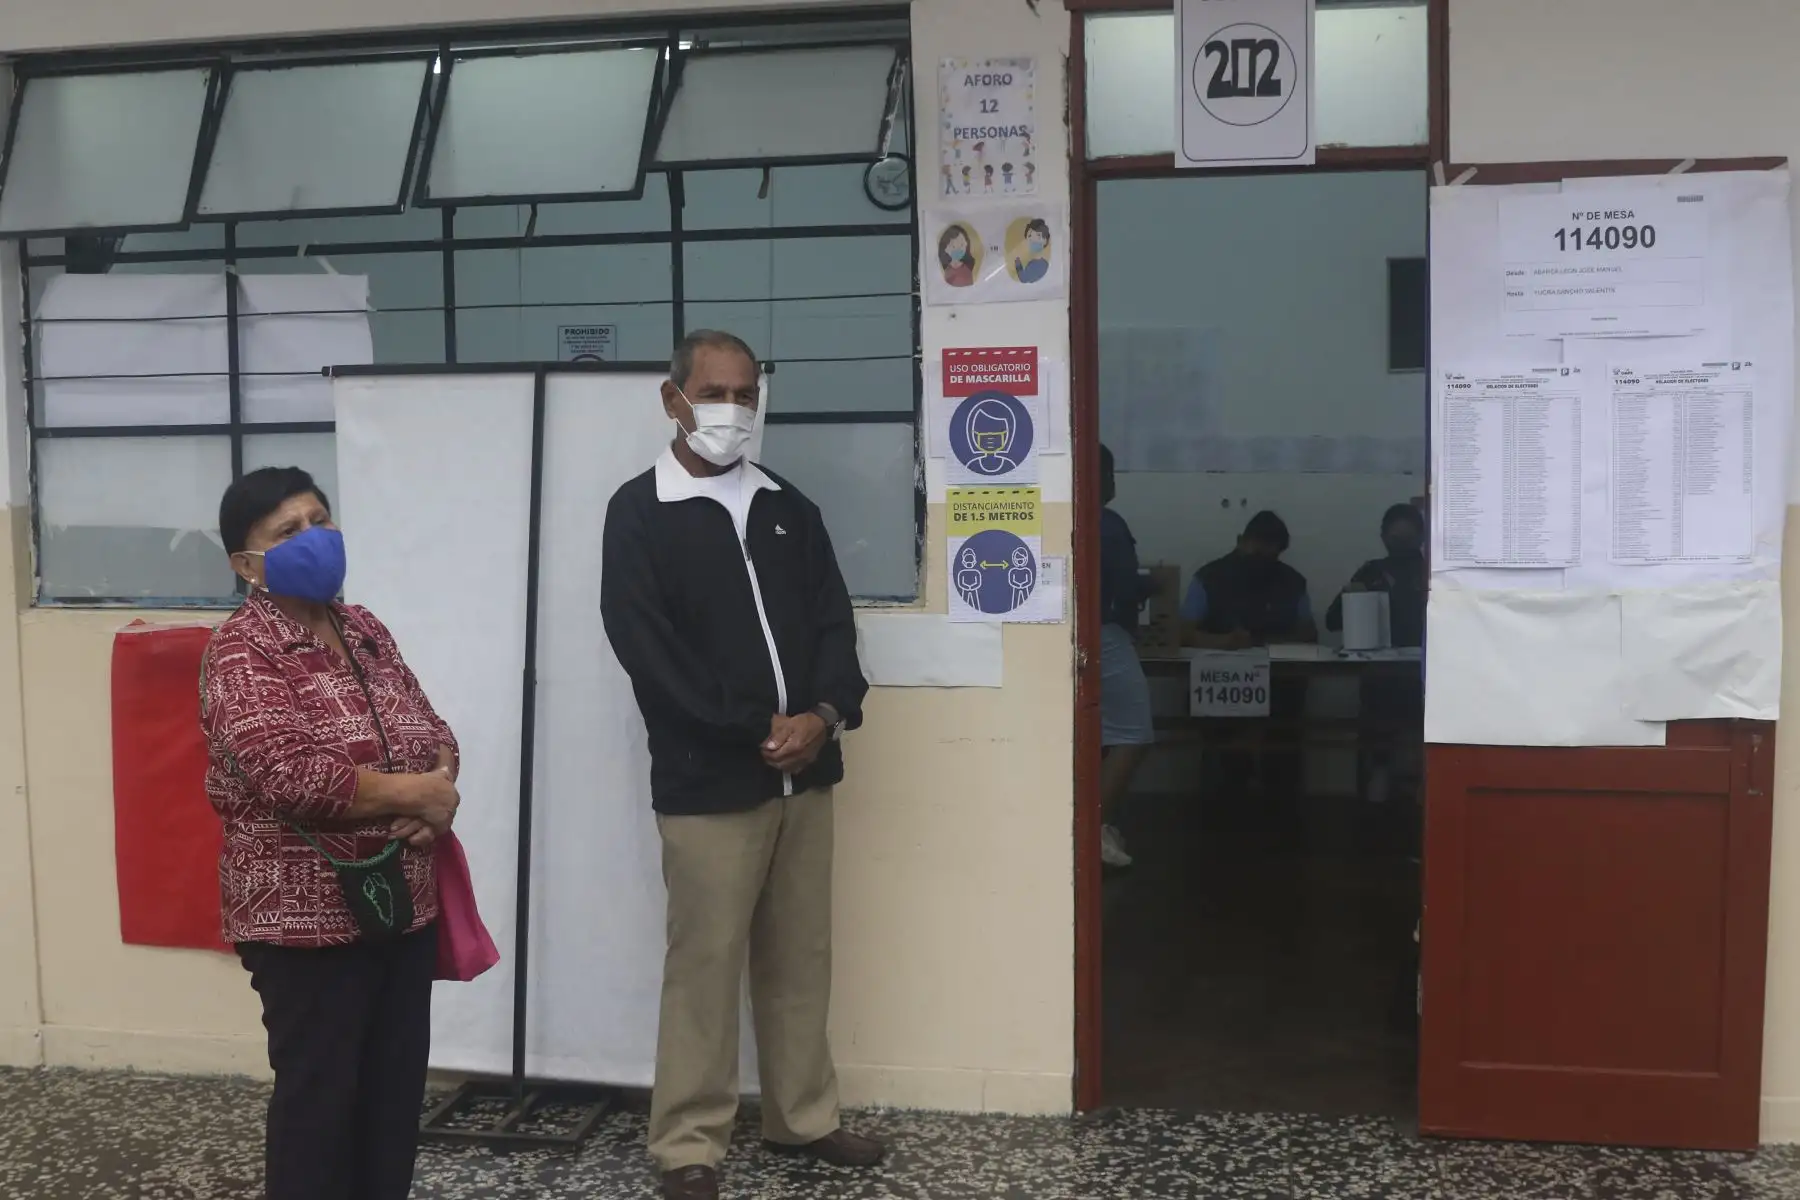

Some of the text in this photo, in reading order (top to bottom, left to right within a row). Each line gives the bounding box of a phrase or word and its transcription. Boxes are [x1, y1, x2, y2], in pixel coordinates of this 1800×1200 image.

[964, 73, 1013, 87] AFORO
[979, 99, 999, 114] 12
[953, 125, 1028, 140] PERSONAS
[1587, 211, 1601, 220] DE
[1604, 210, 1635, 220] MESA
[1554, 225, 1656, 251] 114090
[950, 363, 1031, 373] USO OBLIGATORIO
[950, 373, 1031, 384] DE MASCARILLA
[953, 501, 1035, 511] DISTANCIAMIENTO
[953, 511, 1034, 522] DE 1.5 METROS
[1200, 669, 1240, 683] MESA
[1193, 686, 1266, 704] 114090
